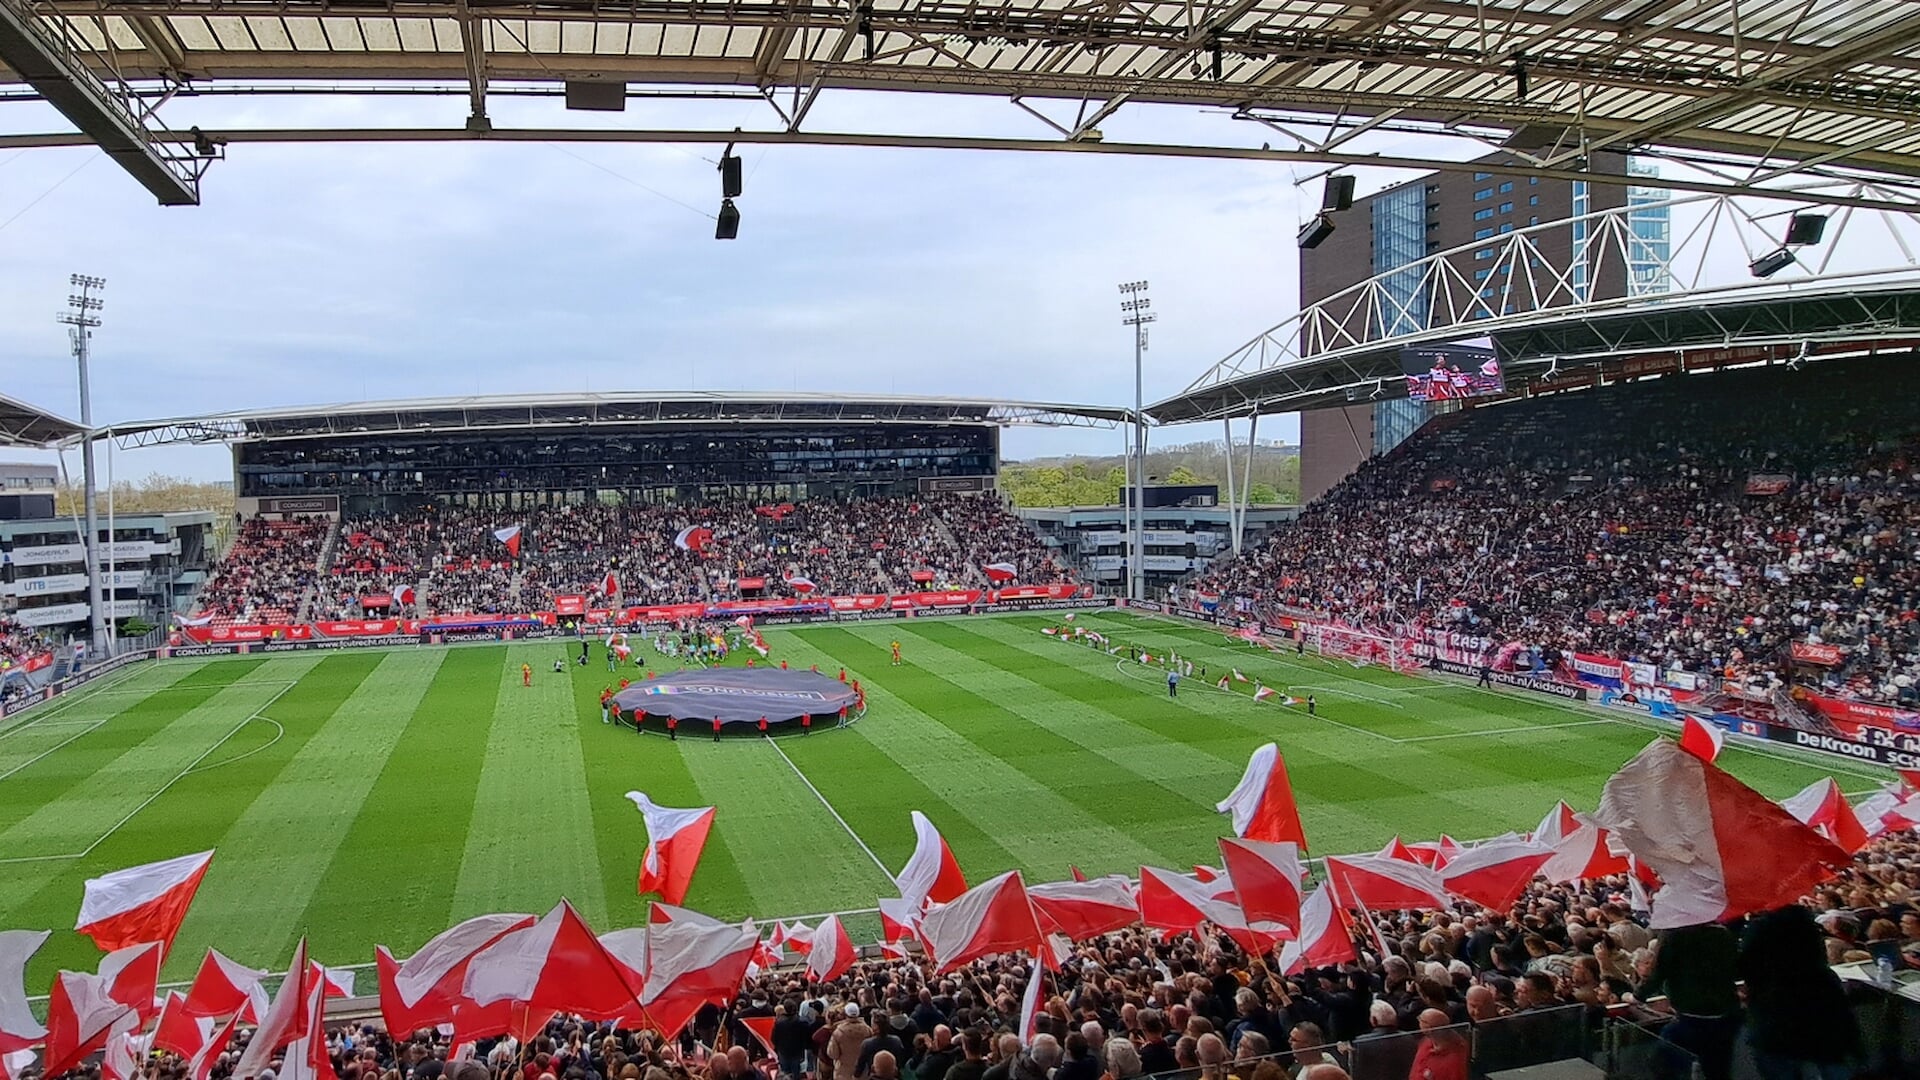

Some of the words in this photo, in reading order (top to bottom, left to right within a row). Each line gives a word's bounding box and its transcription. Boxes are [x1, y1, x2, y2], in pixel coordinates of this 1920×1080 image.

[282, 501, 322, 509] CONCLUSION
[24, 581, 45, 591] UTB
[918, 607, 961, 616] CONCLUSION
[264, 643, 294, 651] doneer
[175, 648, 231, 656] CONCLUSION
[6, 694, 43, 714] CONCLUSION
